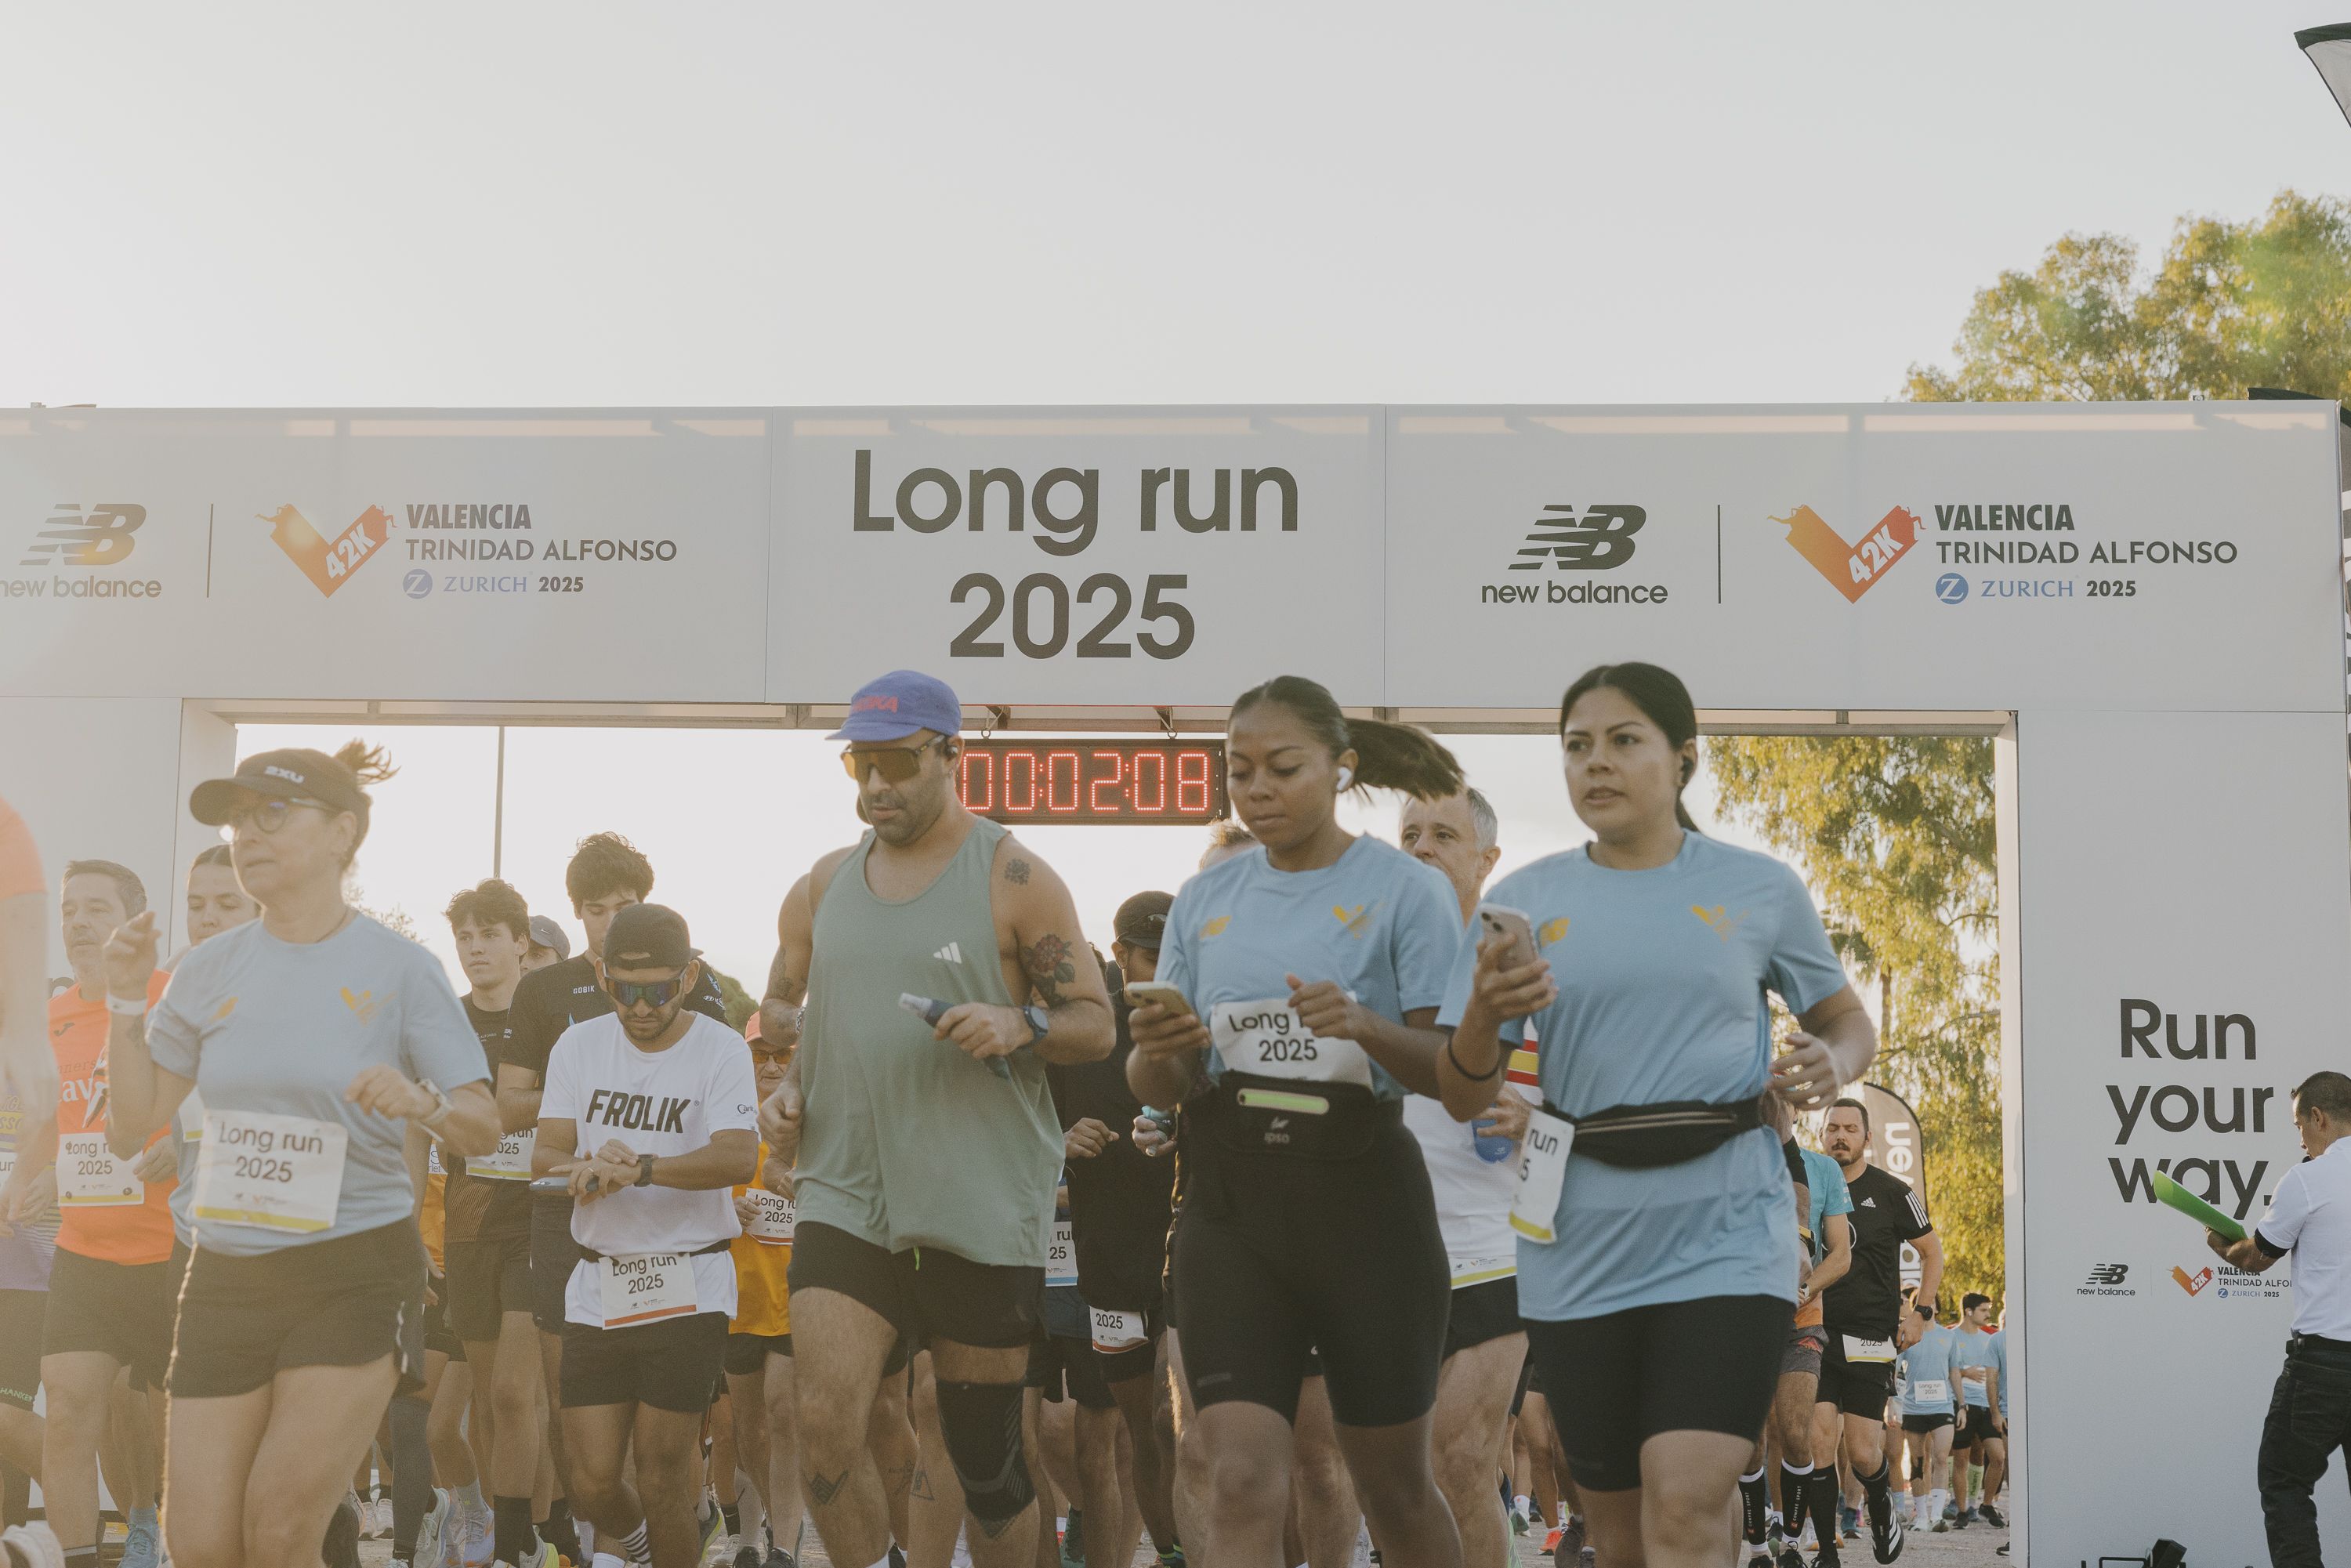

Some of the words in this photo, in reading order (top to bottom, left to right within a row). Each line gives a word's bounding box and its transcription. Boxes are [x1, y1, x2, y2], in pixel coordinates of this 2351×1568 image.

[853, 449, 1098, 556] Long
[1140, 466, 1298, 534] run
[406, 504, 531, 530] VALENCIA
[1934, 504, 2075, 531] VALENCIA
[326, 523, 375, 578] 42K
[405, 539, 534, 560] TRINIDAD
[542, 539, 676, 562] ALFONSO
[1848, 523, 1904, 584] 42K
[1936, 541, 2079, 564] TRINIDAD
[2089, 541, 2237, 564] ALFONSO
[53, 575, 162, 598] balance
[443, 576, 527, 592] ZURICH
[538, 576, 584, 592] 2025
[1481, 585, 1540, 603] new
[1547, 580, 1668, 604] balance
[1981, 580, 2074, 597] ZURICH
[2086, 580, 2136, 597] 2025
[950, 572, 1195, 660] 2025
[962, 751, 1210, 812] 00:02:08
[573, 985, 595, 994] GOBIK
[1229, 1012, 1290, 1035] Long
[2120, 998, 2257, 1060] Run
[1259, 1038, 1317, 1062] 2025
[585, 1088, 691, 1134] FROLIK
[2106, 1085, 2273, 1145] your
[219, 1121, 273, 1153] Long
[282, 1133, 324, 1154] run
[497, 1142, 520, 1155] 025
[1529, 1128, 1558, 1155] run
[78, 1160, 113, 1175] 2025
[235, 1155, 293, 1183] 2025
[765, 1211, 792, 1224] 2025
[1056, 1230, 1070, 1241] ru
[1049, 1246, 1067, 1260] 25
[612, 1258, 647, 1277] Long
[650, 1255, 677, 1269] run
[628, 1273, 664, 1295] 2025
[2097, 1286, 2135, 1296] balance
[2190, 1273, 2208, 1291] 42K
[2218, 1278, 2262, 1287] TRINIDAD
[2265, 1279, 2291, 1287] ALFO
[1096, 1313, 1123, 1329] 2025
